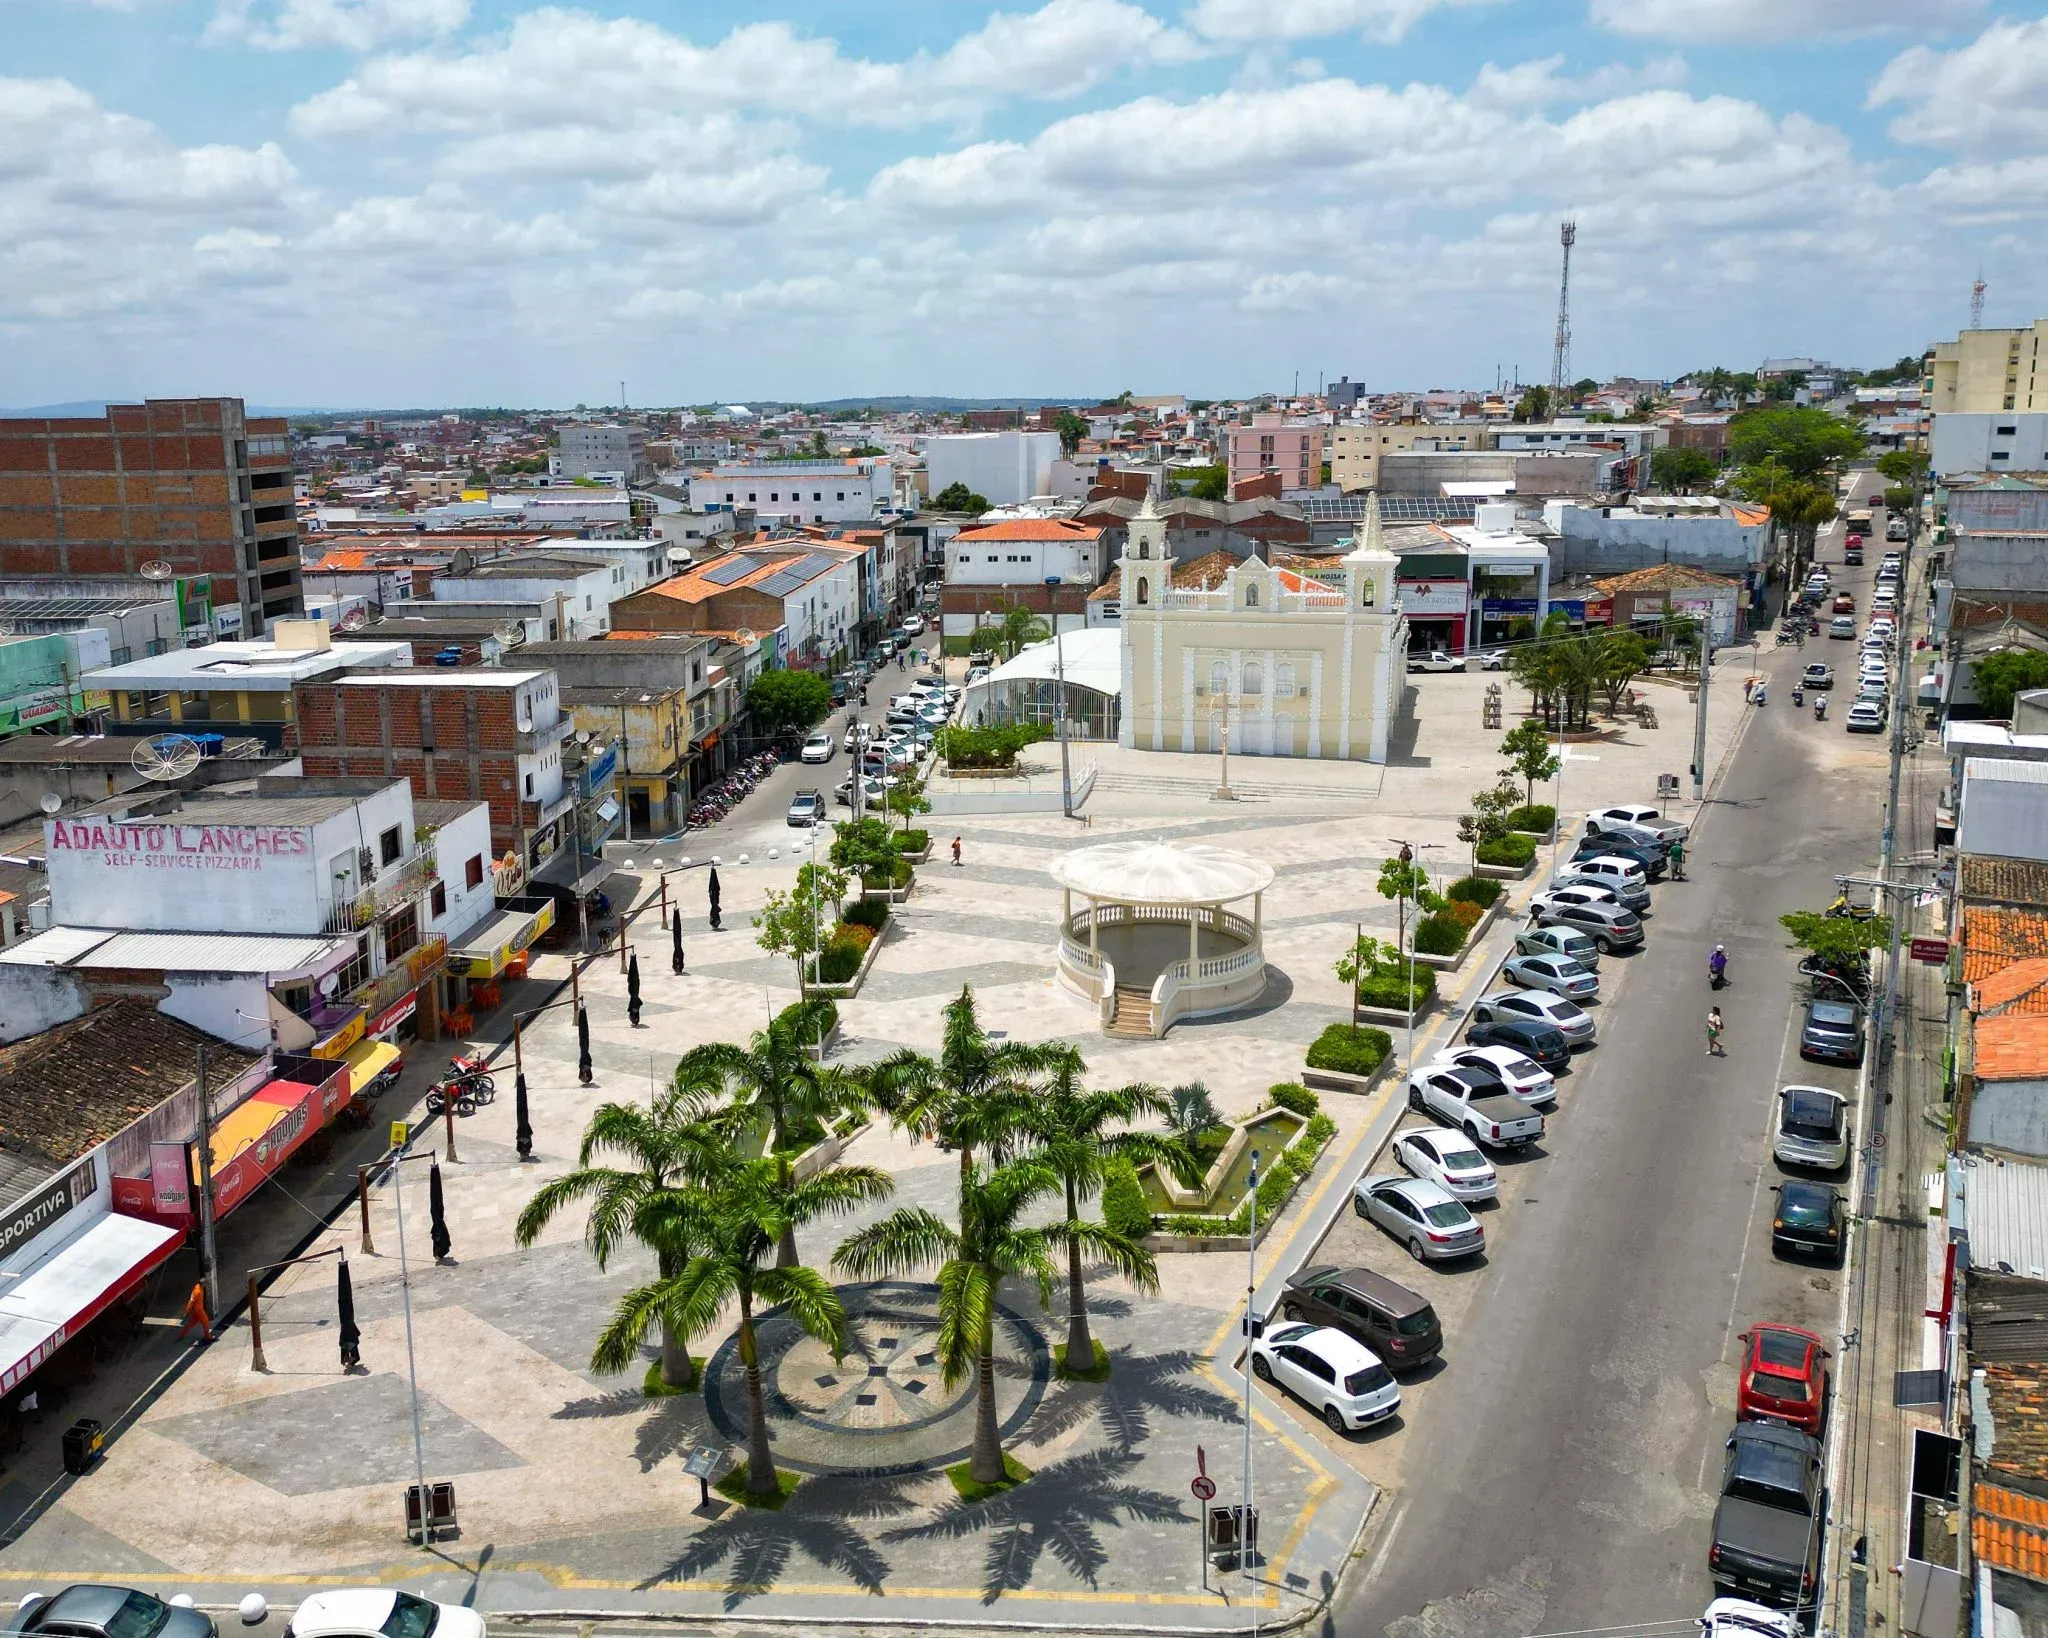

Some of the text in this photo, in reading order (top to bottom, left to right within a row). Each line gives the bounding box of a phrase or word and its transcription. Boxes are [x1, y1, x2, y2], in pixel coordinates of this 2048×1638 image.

[1431, 597, 1460, 605] MODA
[52, 821, 308, 856] ADAUTO LANCHES
[104, 853, 194, 869] SELF-SERVICE
[205, 856, 263, 871] PIZZARIA
[386, 1005, 408, 1025] HONDA
